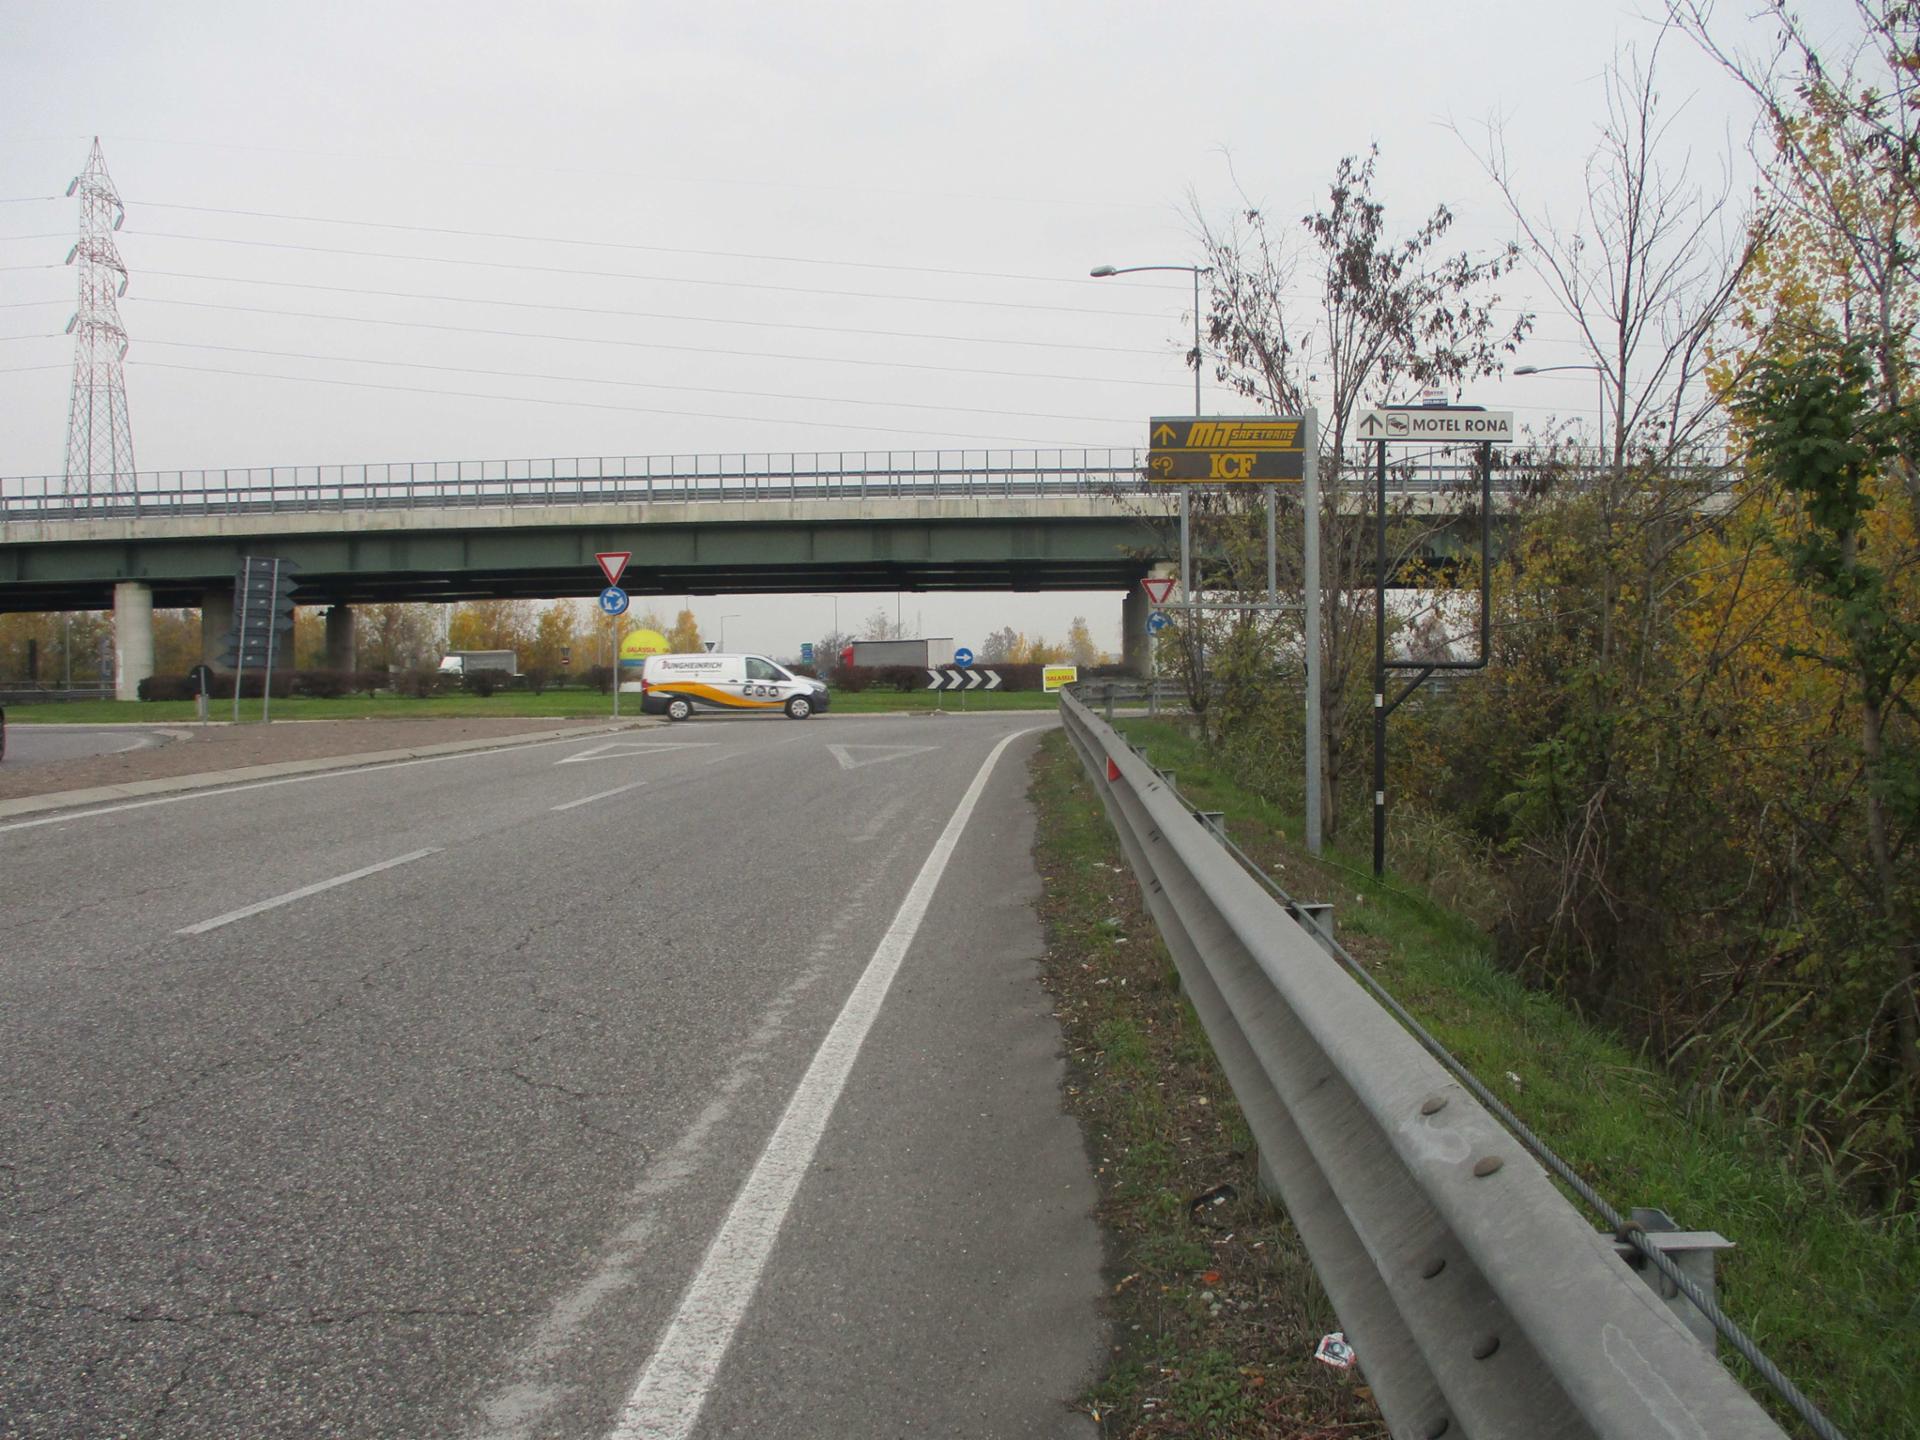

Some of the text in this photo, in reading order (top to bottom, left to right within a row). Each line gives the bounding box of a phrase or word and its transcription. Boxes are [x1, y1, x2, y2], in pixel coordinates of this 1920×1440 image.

[1413, 419, 1508, 432] MOTEL RONA
[1209, 453, 1257, 479] ICF
[662, 660, 723, 670] JUNGHEINRICH
